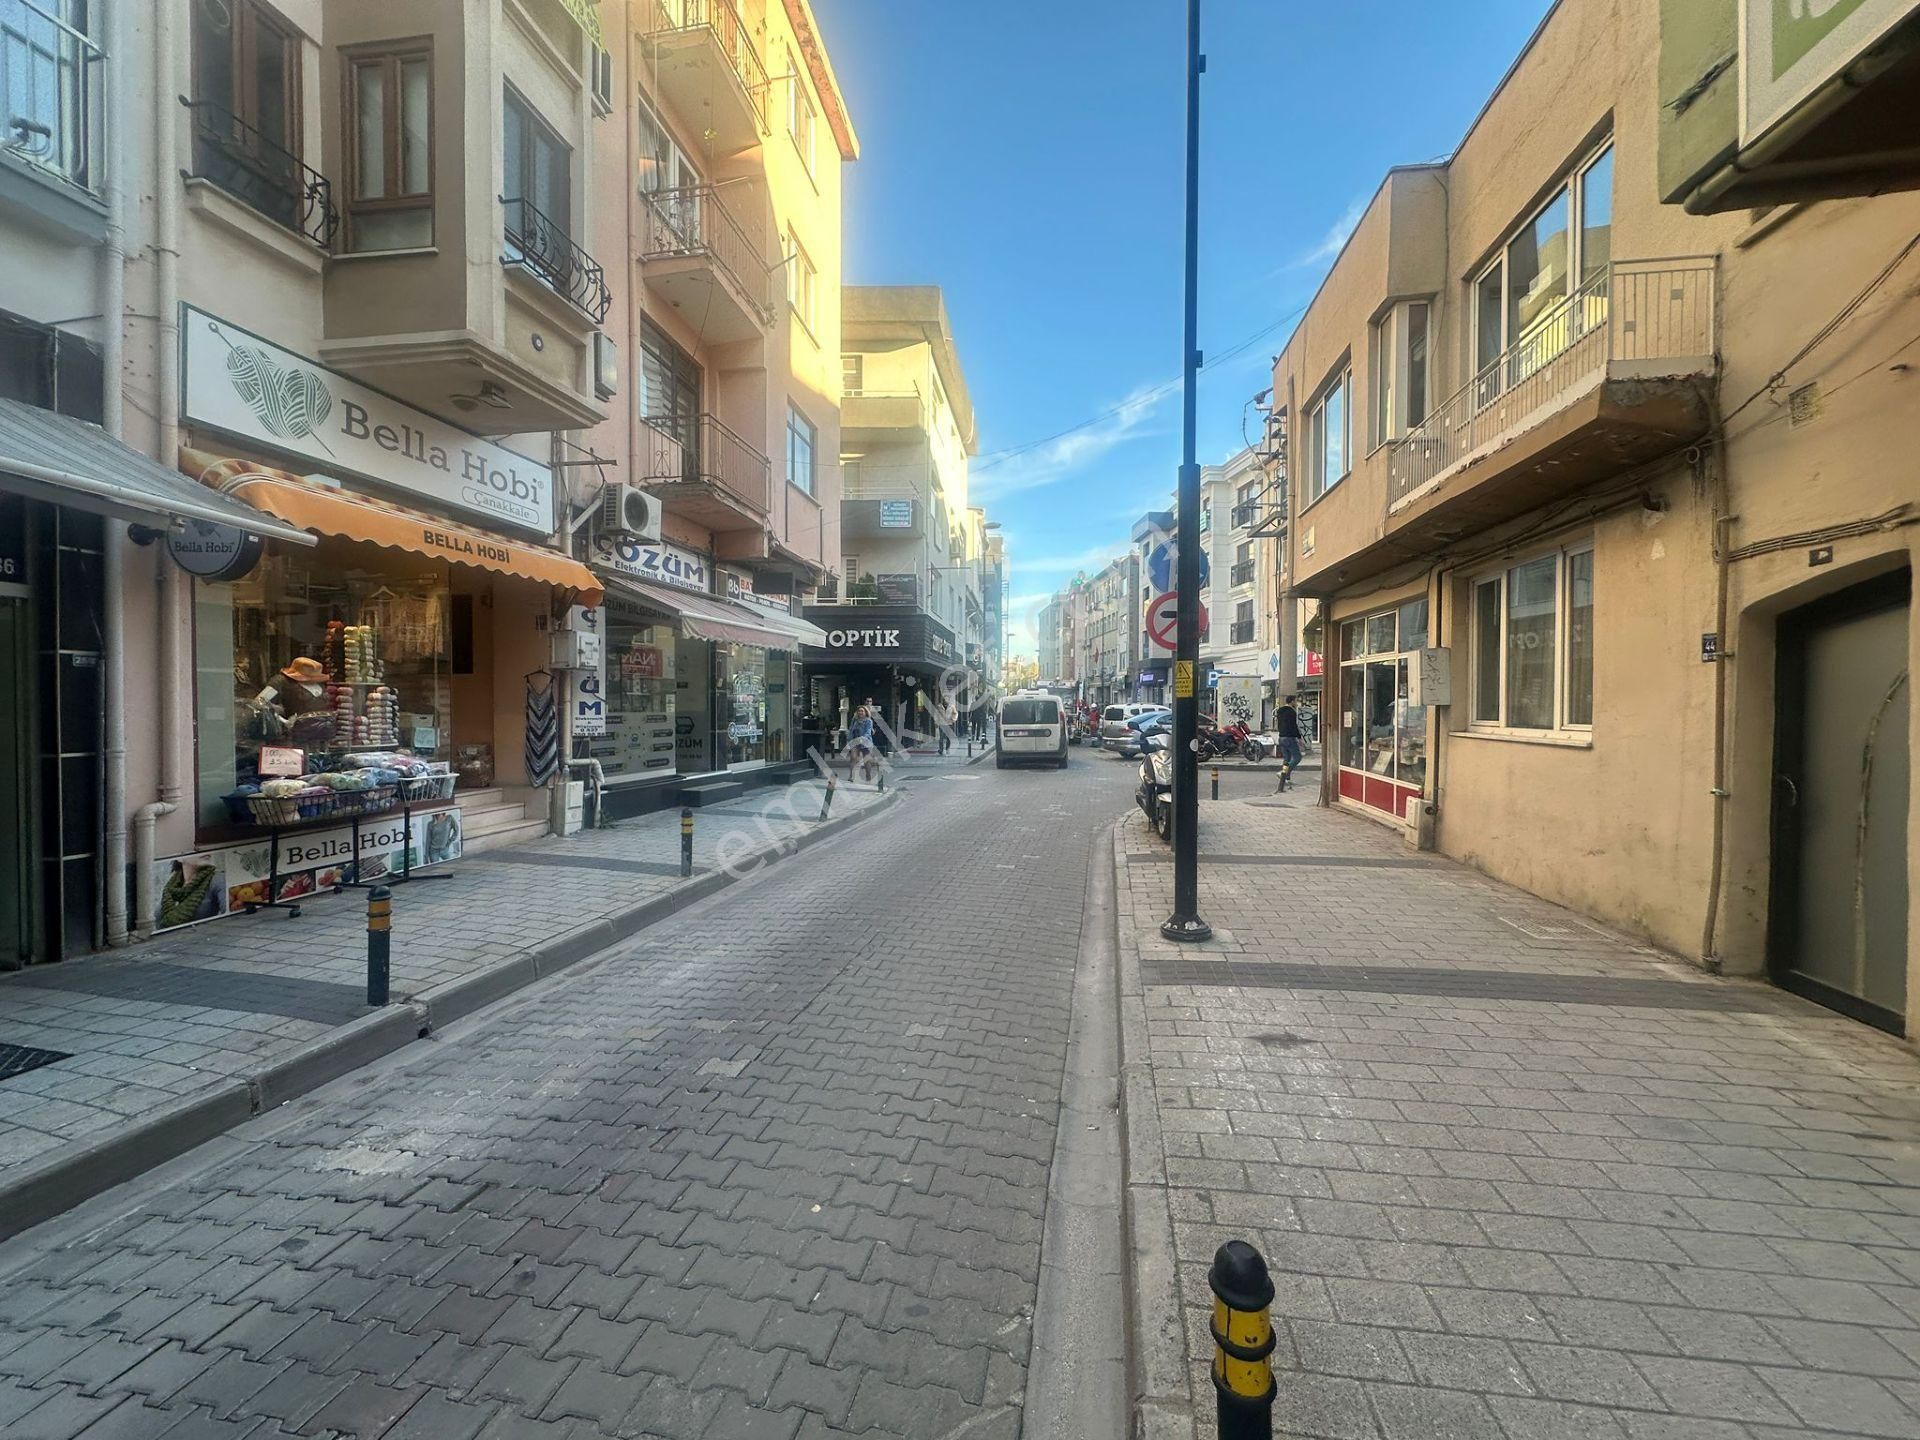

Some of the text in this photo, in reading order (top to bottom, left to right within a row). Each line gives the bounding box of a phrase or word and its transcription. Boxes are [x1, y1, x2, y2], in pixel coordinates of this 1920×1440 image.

[341, 399, 450, 472] Bella
[473, 492, 530, 519] Çanakkale
[175, 542, 233, 553] Bella Hobi
[423, 530, 510, 563] BELLA HOBİ
[614, 560, 658, 580] Elektronik
[828, 625, 900, 648] OPTİK
[287, 840, 352, 865] Bella
